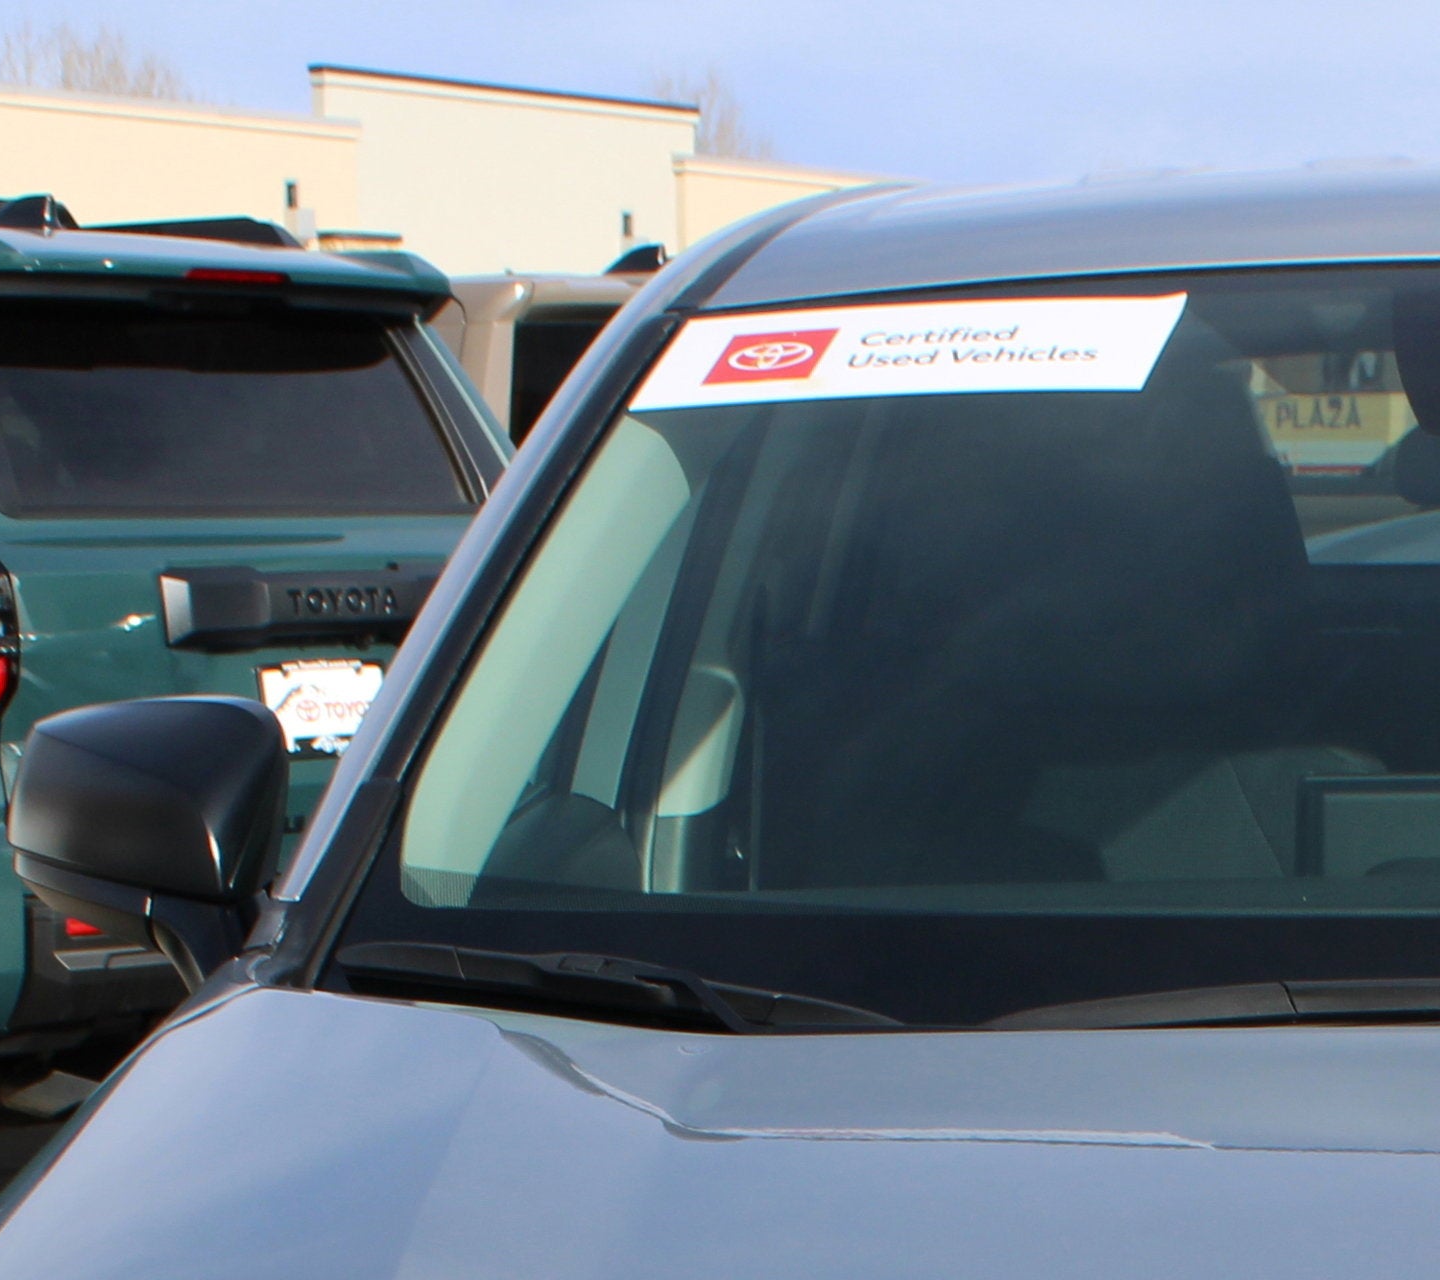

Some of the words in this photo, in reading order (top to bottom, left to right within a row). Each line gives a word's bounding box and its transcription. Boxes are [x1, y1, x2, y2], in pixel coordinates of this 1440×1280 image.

[860, 325, 1020, 348] Certified
[847, 348, 941, 370] Used
[951, 345, 1100, 365] Vehicles
[287, 588, 398, 616] TOYOTA
[324, 701, 368, 719] TOYO
